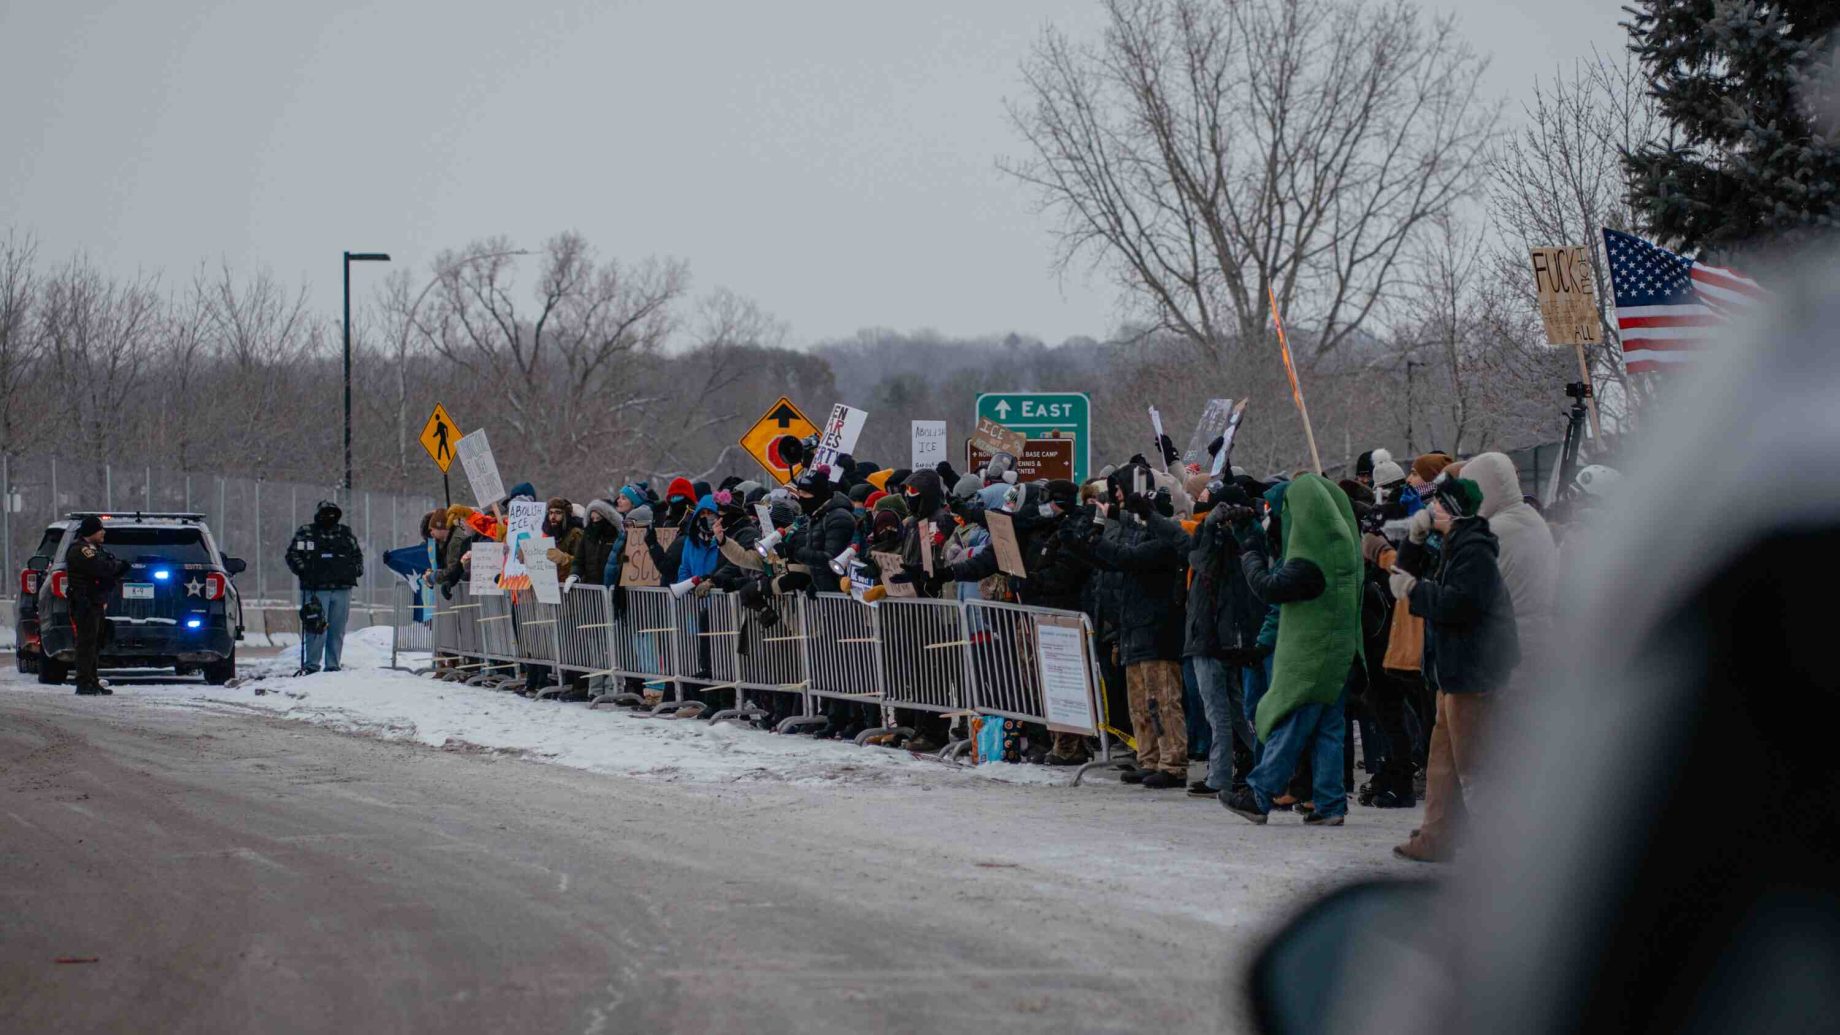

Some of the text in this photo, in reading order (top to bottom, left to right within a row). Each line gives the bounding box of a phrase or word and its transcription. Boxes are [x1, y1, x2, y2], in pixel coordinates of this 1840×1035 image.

[1532, 249, 1581, 294] FUCK
[1576, 247, 1593, 295] ICE
[1574, 325, 1595, 341] ALL
[1021, 401, 1073, 417] EAST
[915, 426, 945, 439] ABOLISH
[980, 419, 1005, 440] ICE
[919, 441, 937, 453] ICE
[510, 505, 542, 519] ABOLISH
[510, 517, 528, 532] ICE
